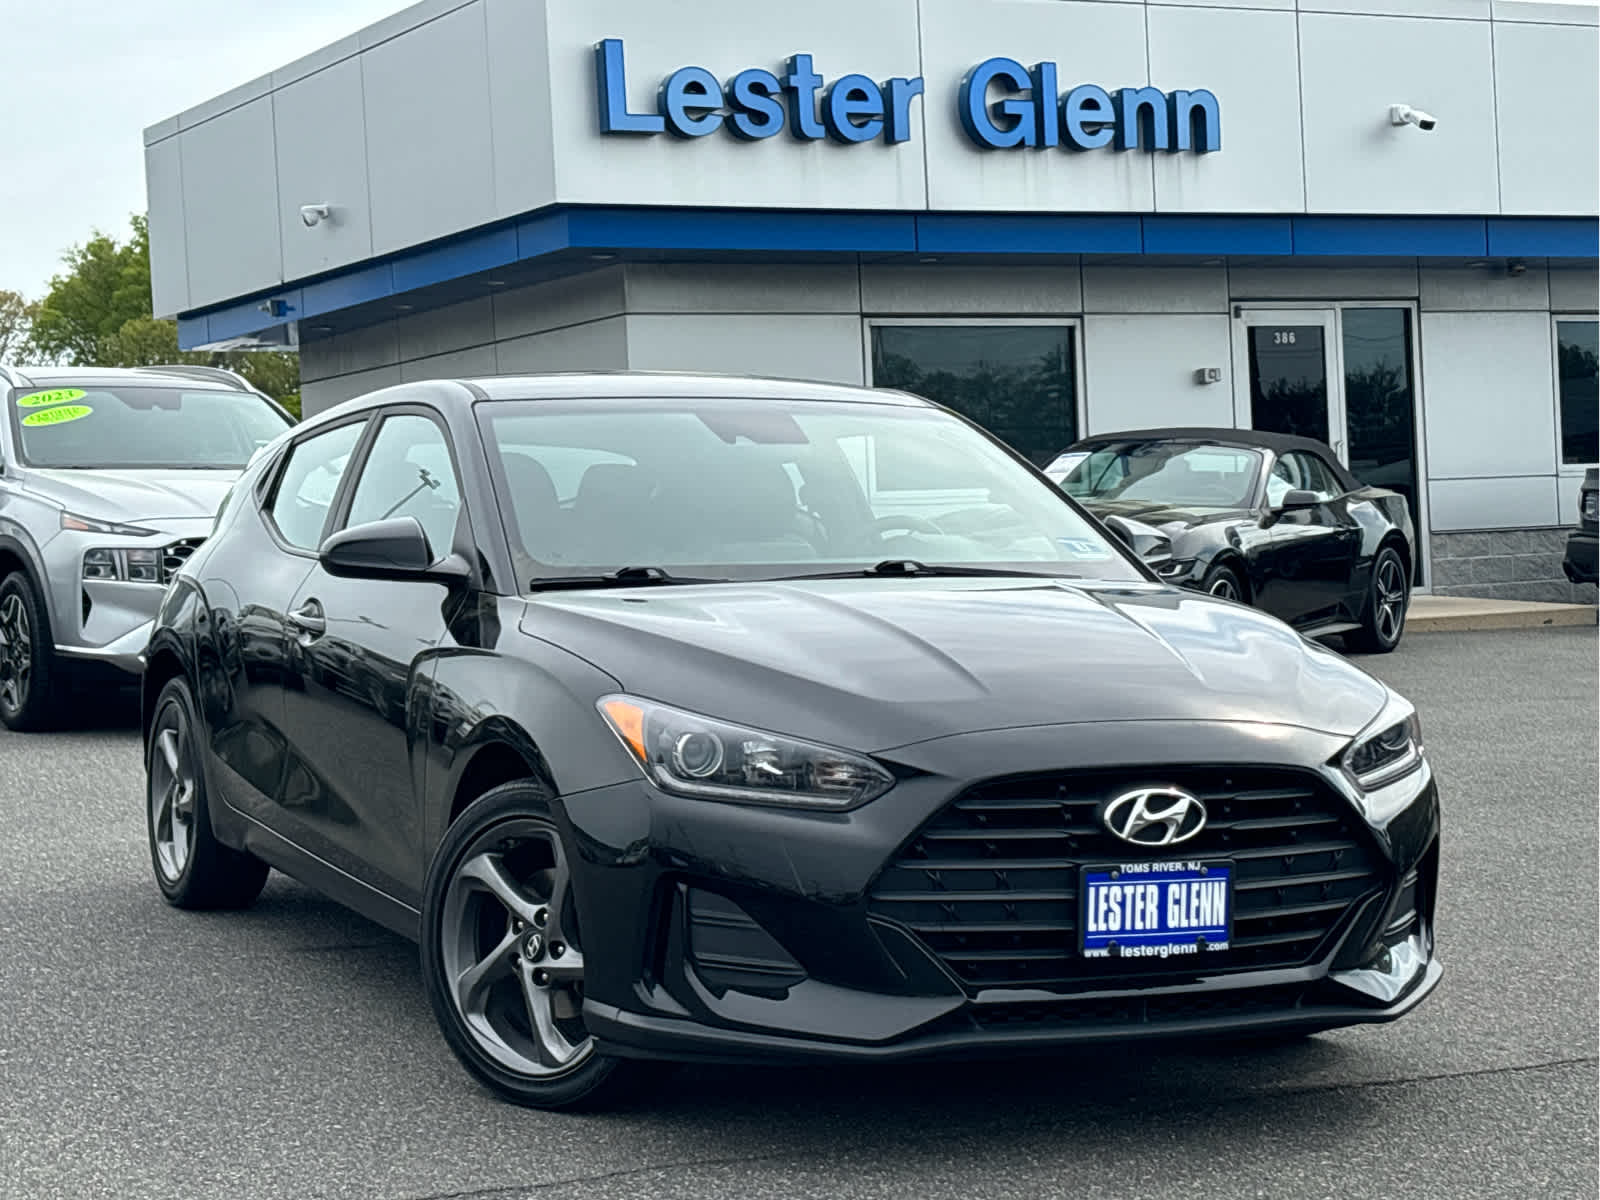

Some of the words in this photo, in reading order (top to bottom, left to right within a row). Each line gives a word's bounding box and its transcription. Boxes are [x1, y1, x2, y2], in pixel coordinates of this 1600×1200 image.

[595, 39, 924, 144] Lester
[960, 56, 1221, 154] Glenn
[1273, 331, 1297, 345] 386
[1120, 863, 1149, 874] TOMS
[1187, 861, 1200, 871] NJ
[1088, 884, 1159, 932] LESTER
[1167, 881, 1226, 929] GLENN
[1084, 948, 1110, 958] www.
[1120, 943, 1198, 959] lesterglenn
